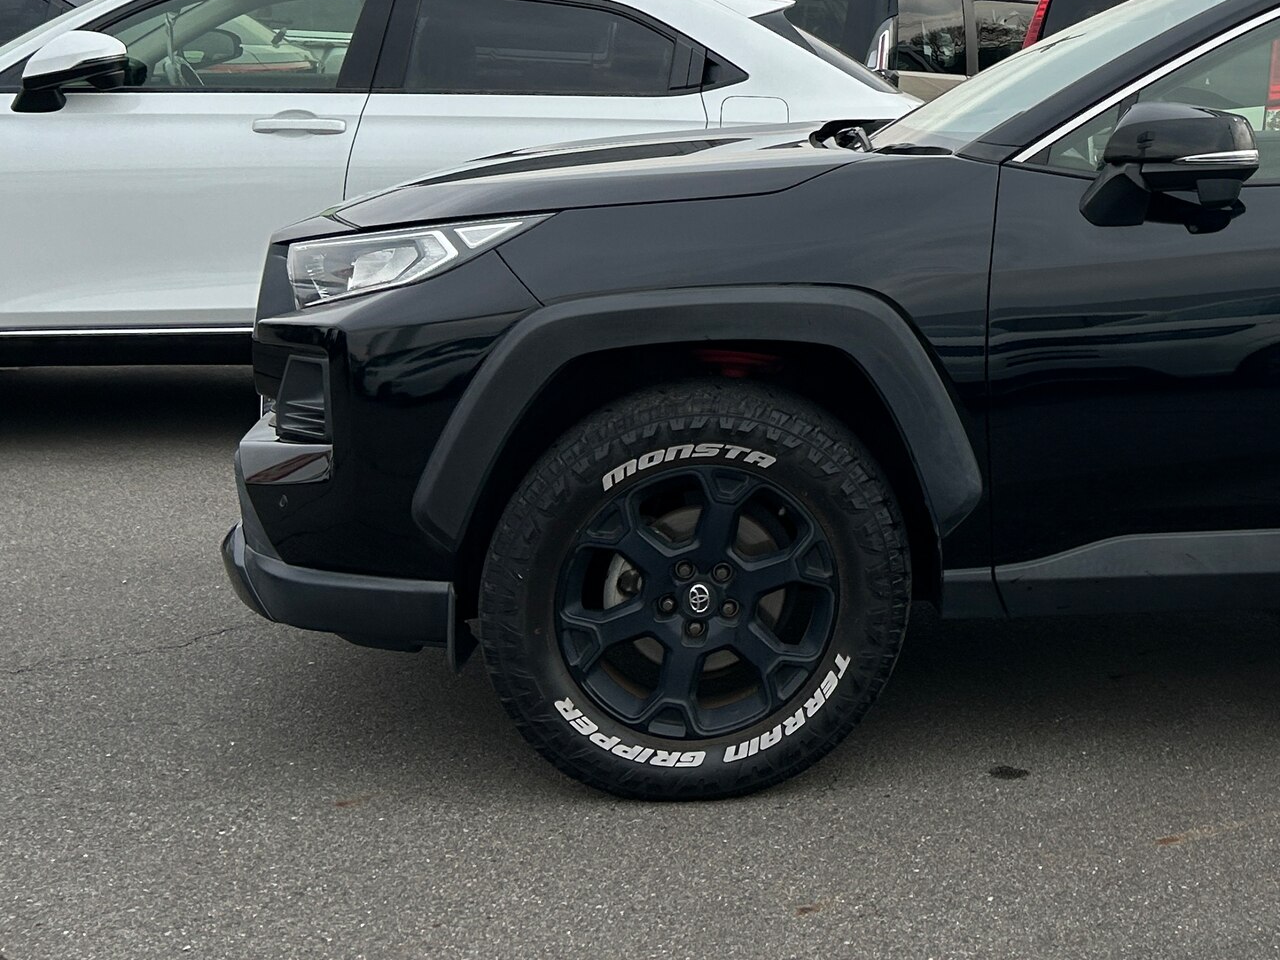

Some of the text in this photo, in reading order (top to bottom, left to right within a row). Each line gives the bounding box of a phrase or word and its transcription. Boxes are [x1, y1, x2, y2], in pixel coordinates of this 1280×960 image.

[602, 443, 777, 491] MONSTA
[554, 653, 851, 768] TERRAIN GRIPPER
